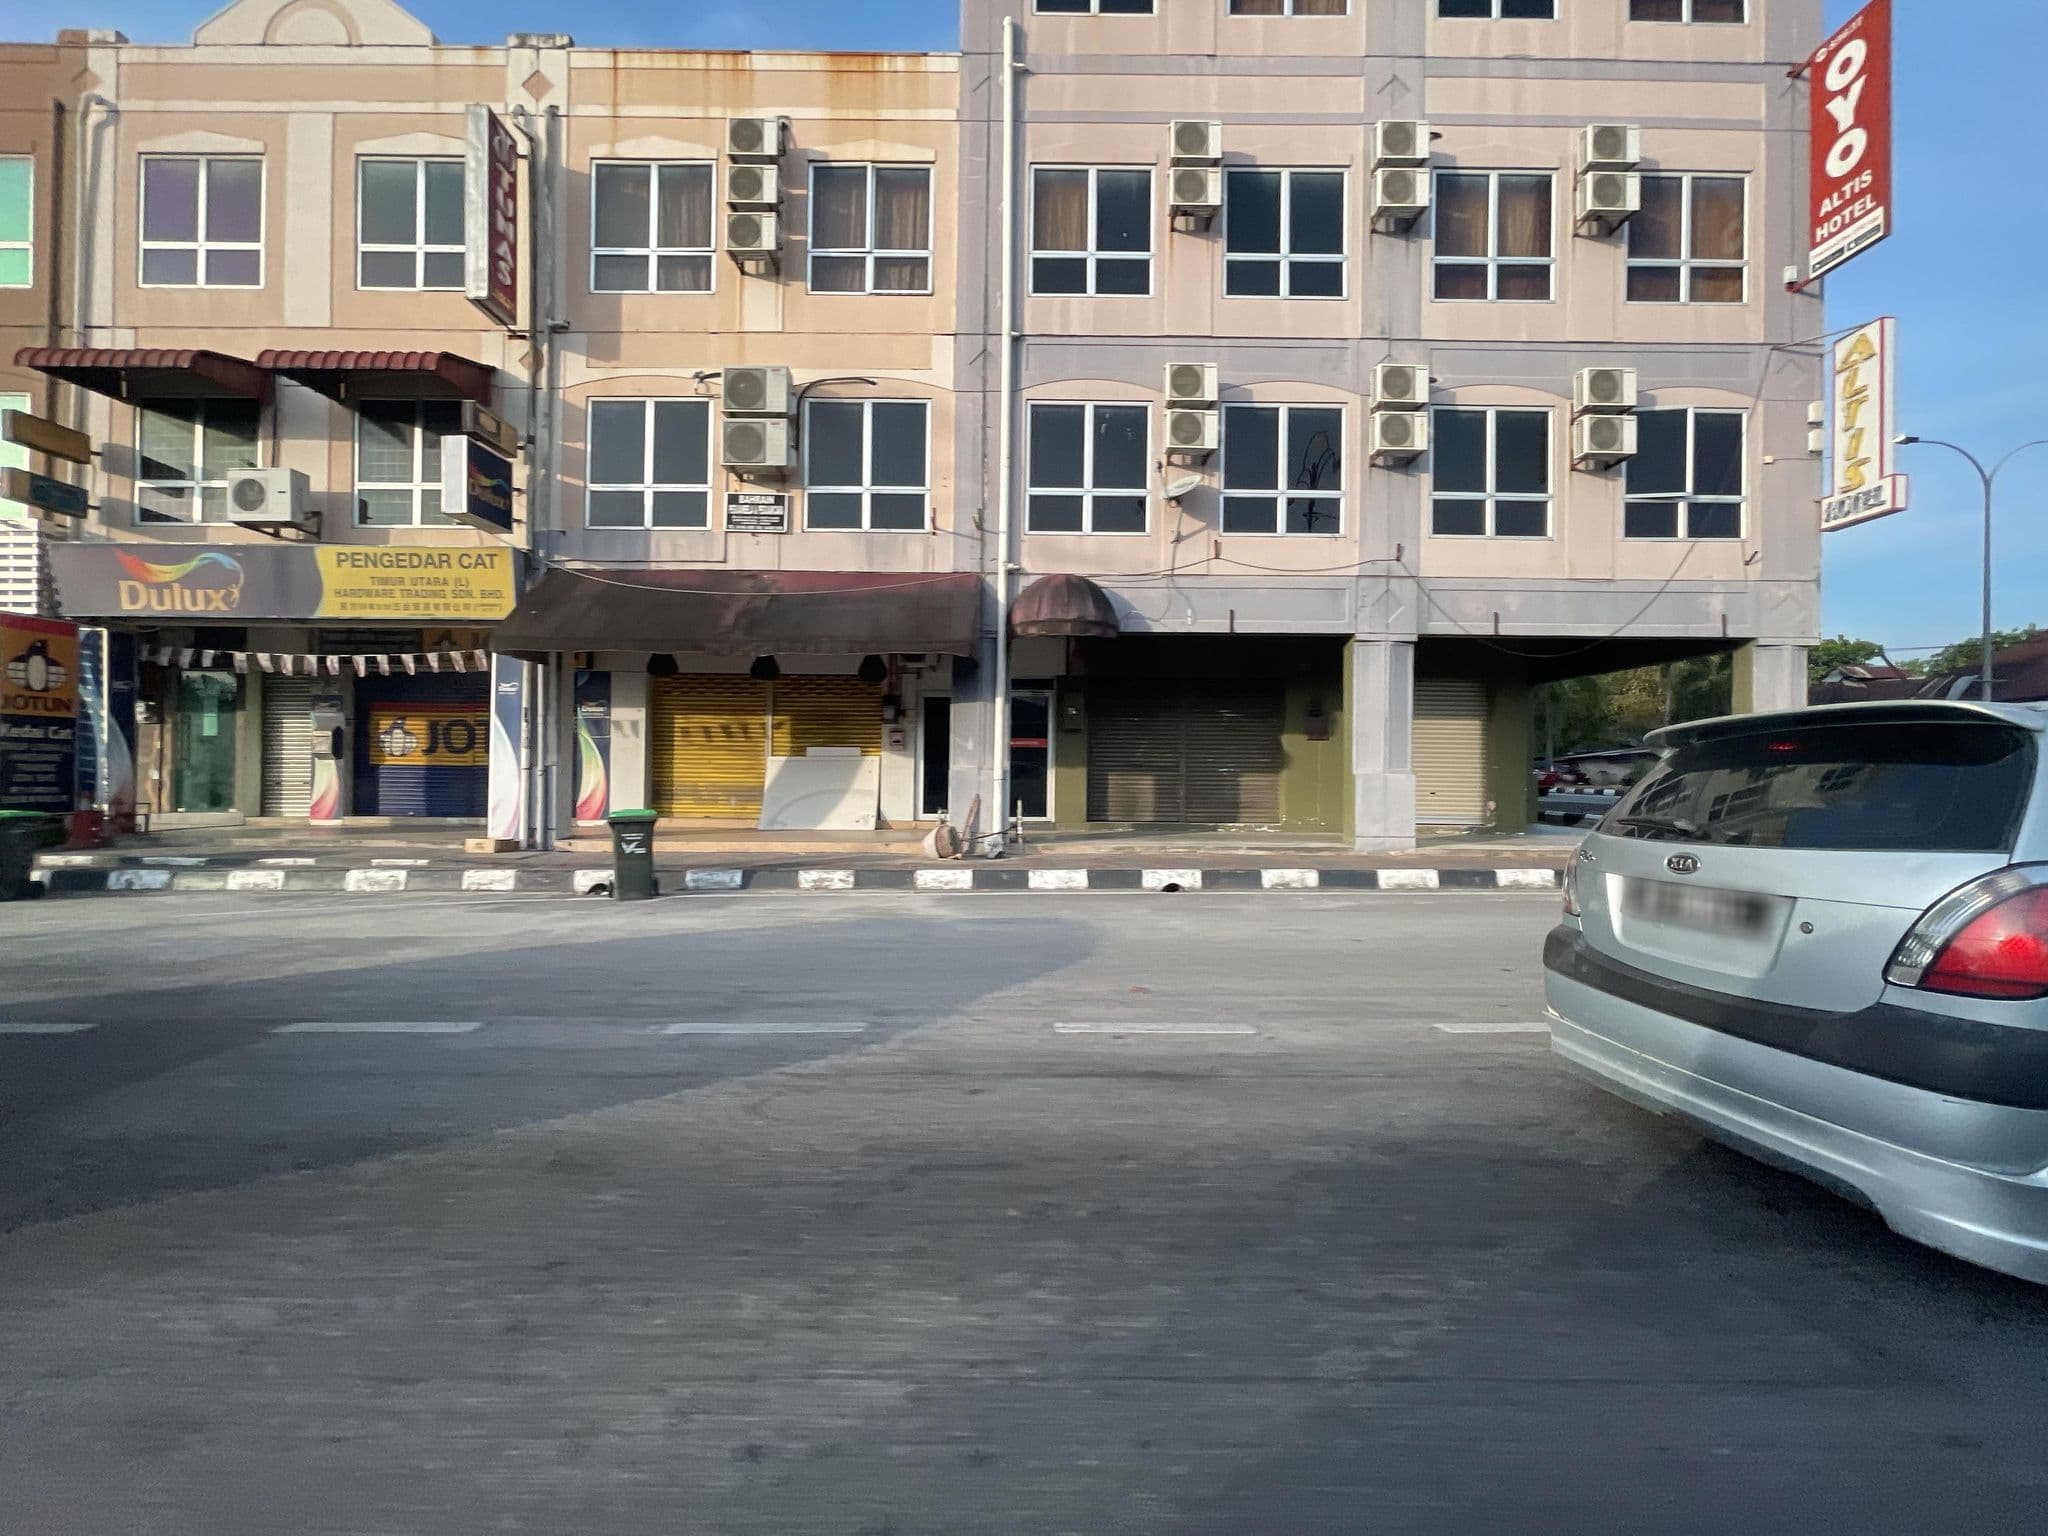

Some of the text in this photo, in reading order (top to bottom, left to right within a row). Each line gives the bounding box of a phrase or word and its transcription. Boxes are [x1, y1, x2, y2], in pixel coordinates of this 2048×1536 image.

[1825, 38, 1868, 178] OYO
[1818, 169, 1874, 218] ALTIS
[1815, 193, 1877, 243] HOTEL
[1835, 333, 1877, 494] ALTIS
[1824, 485, 1887, 522] HOTEL
[336, 552, 498, 569] PENGEDAR CAT
[119, 580, 231, 611] Dulux
[335, 588, 396, 599] HARDWARE
[400, 588, 447, 599] TRADING
[410, 576, 449, 587] UTARA
